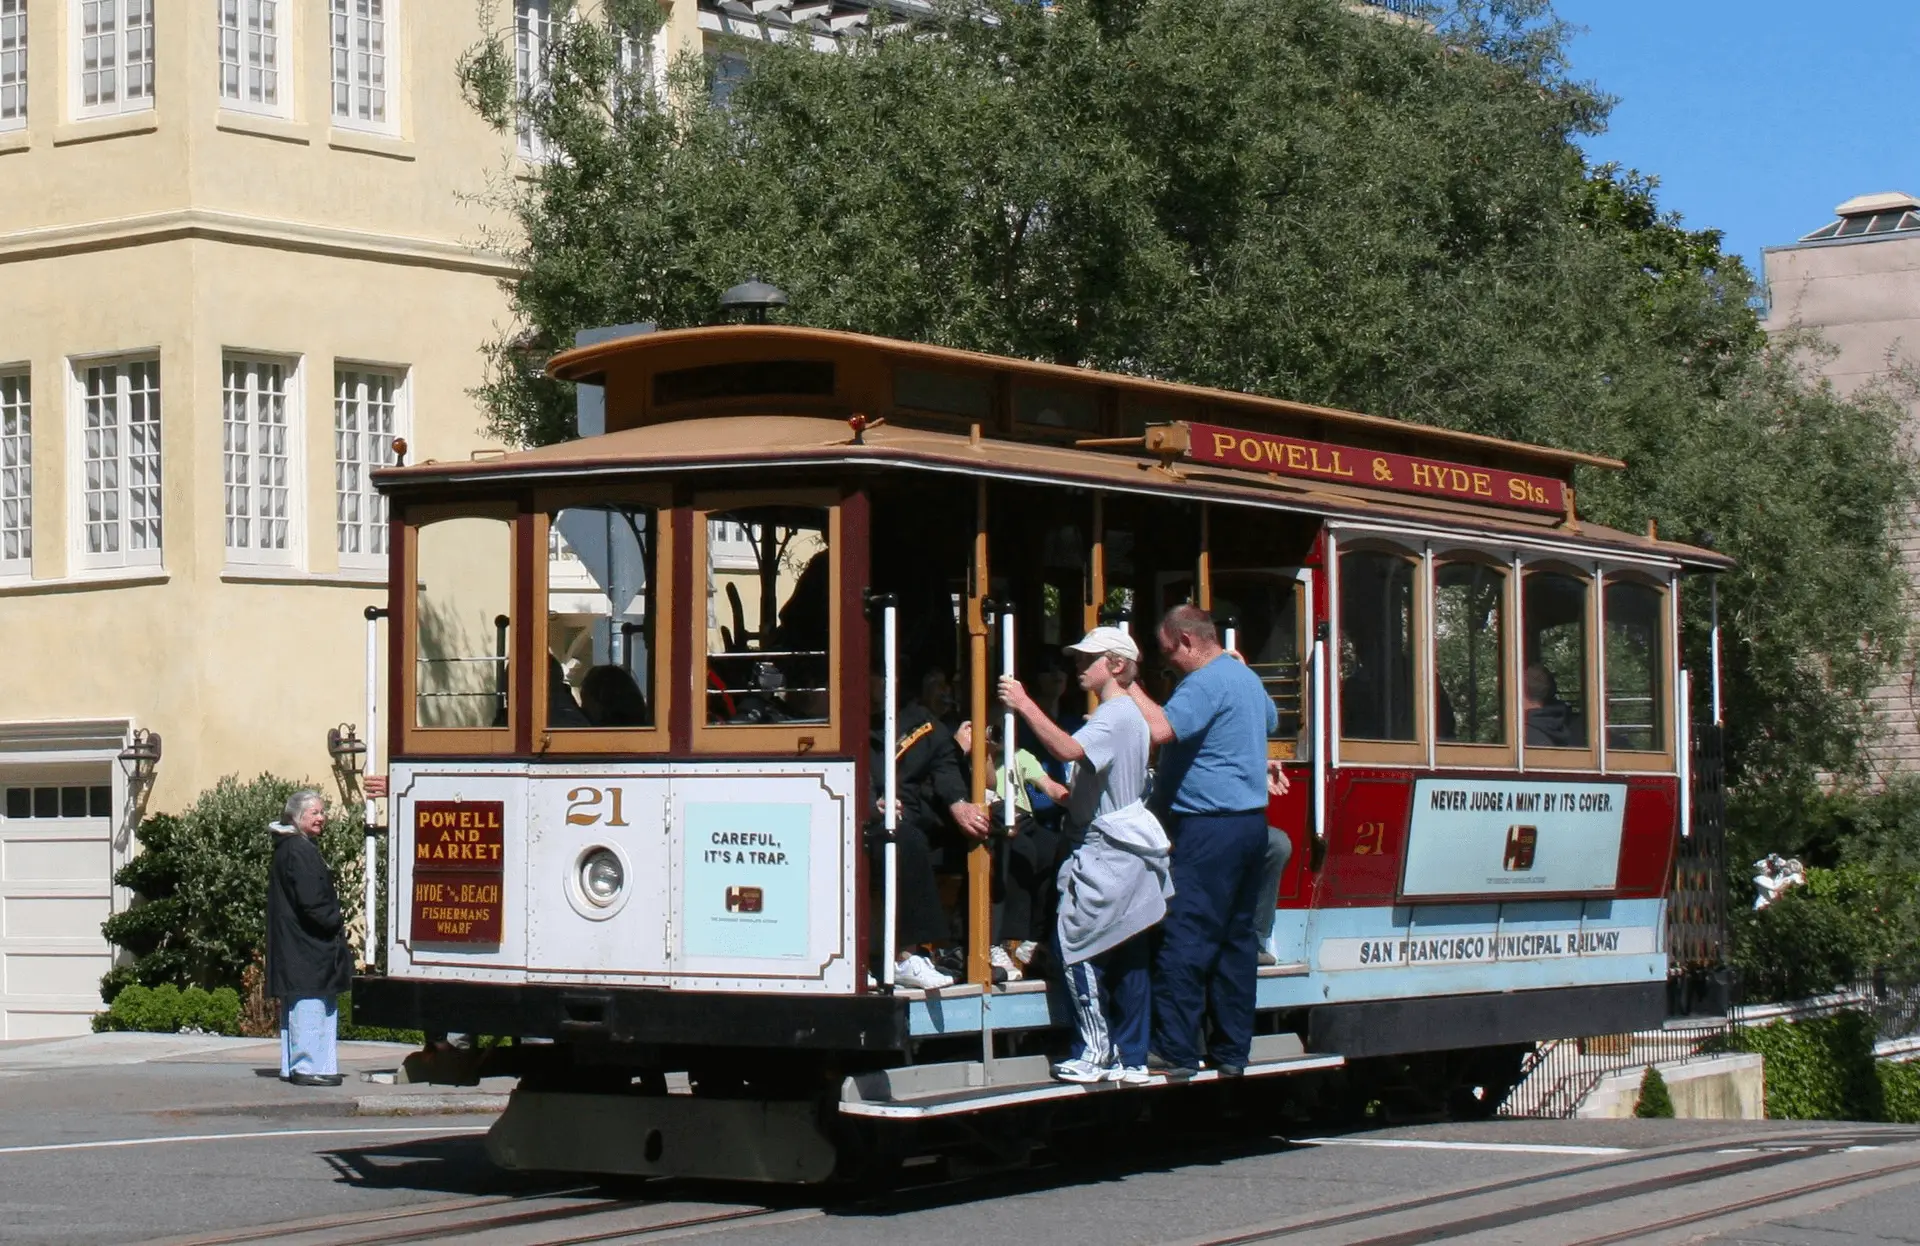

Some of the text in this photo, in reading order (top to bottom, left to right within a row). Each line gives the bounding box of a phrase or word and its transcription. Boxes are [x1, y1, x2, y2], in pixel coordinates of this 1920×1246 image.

[1213, 433, 1550, 504] POWELL & HYDE Sts.
[565, 786, 630, 827] 21
[1431, 790, 1613, 813] NEVER JUDGE A MINT BY ITS COVER.
[419, 811, 499, 828] POWELL
[440, 829, 480, 842] AND
[711, 831, 781, 849] CAREFUL,
[1354, 822, 1385, 855] 21
[417, 843, 501, 860] MARKET
[704, 849, 789, 866] IT'S A TRAP.
[416, 884, 443, 903] HYDE
[461, 884, 498, 904] BEACH
[422, 907, 490, 921] FISHERMANS
[437, 922, 472, 935] WHARF
[1360, 931, 1620, 964] SAN FRANCISCO MUNICIPAL RAILWAY
